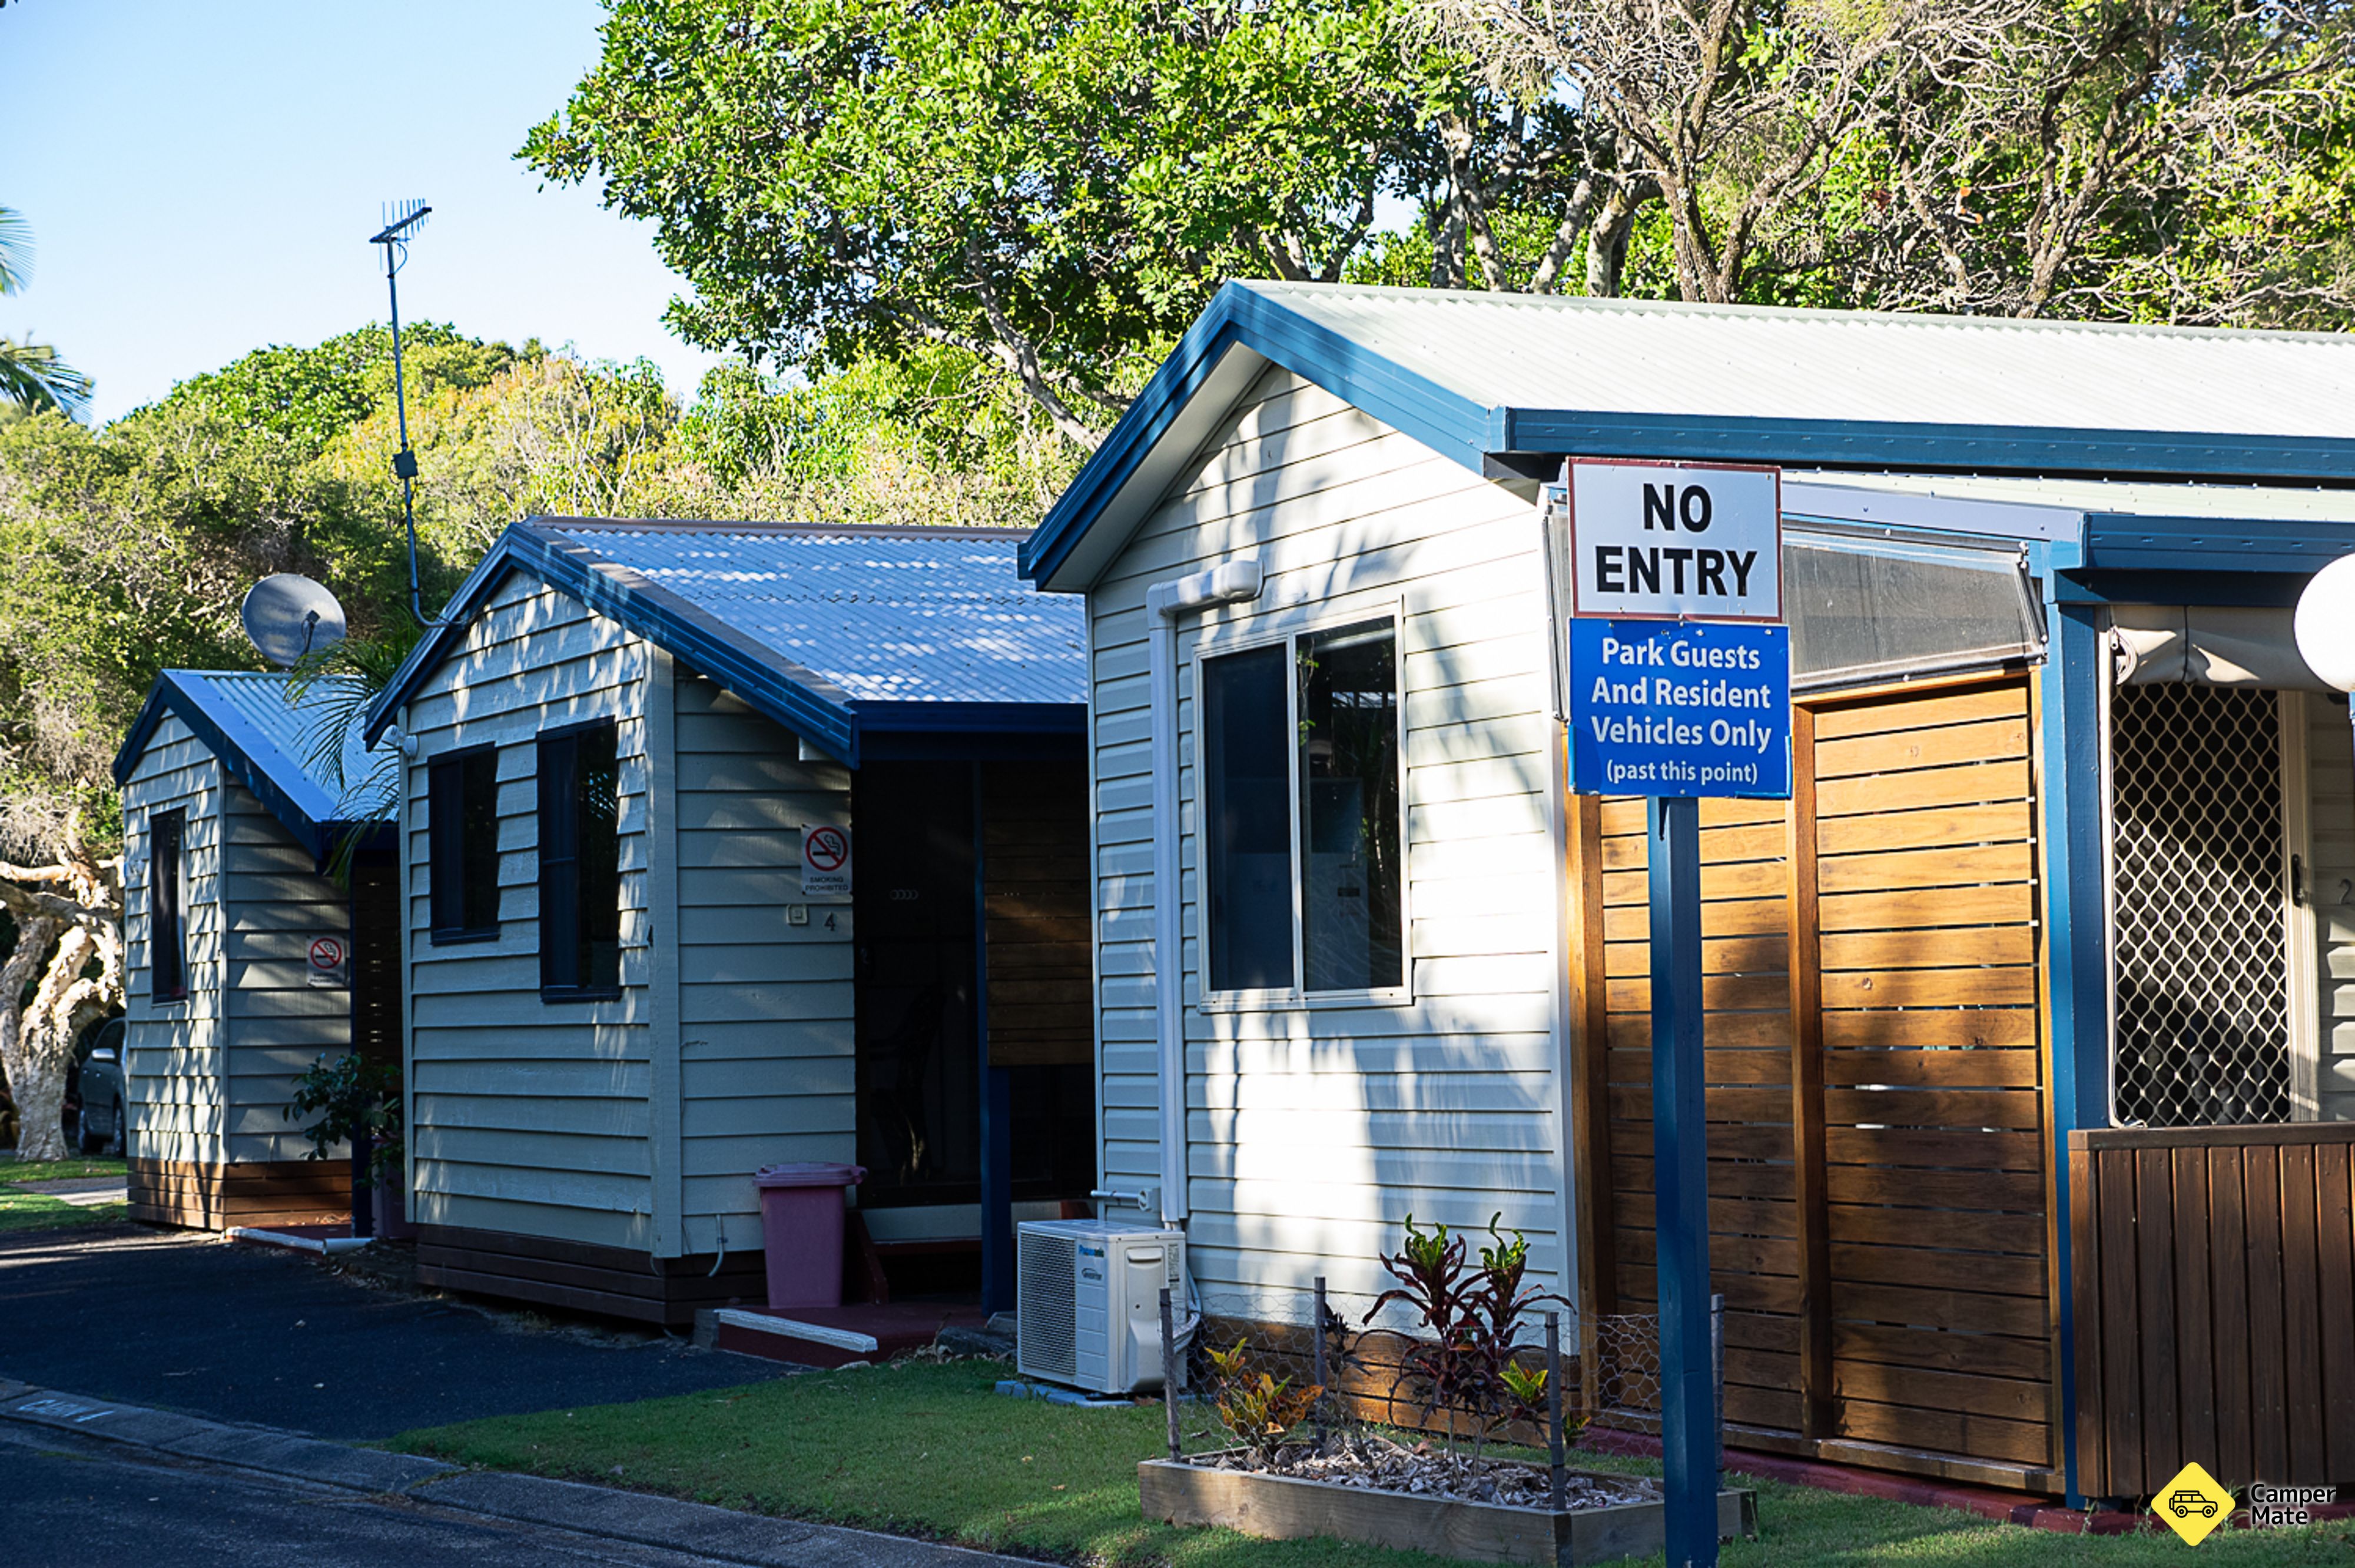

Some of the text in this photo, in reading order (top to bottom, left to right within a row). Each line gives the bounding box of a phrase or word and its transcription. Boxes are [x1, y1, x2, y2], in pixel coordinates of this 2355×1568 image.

[1642, 483, 1713, 533] NO
[1595, 545, 1758, 597] ENTRY
[1601, 637, 1761, 670] Park Guests
[1591, 676, 1772, 709] And Resident
[1591, 715, 1772, 755] Vehicles Only
[1606, 758, 1759, 785] (past this point)
[2337, 878, 2352, 905] 2
[824, 912, 835, 931] 4
